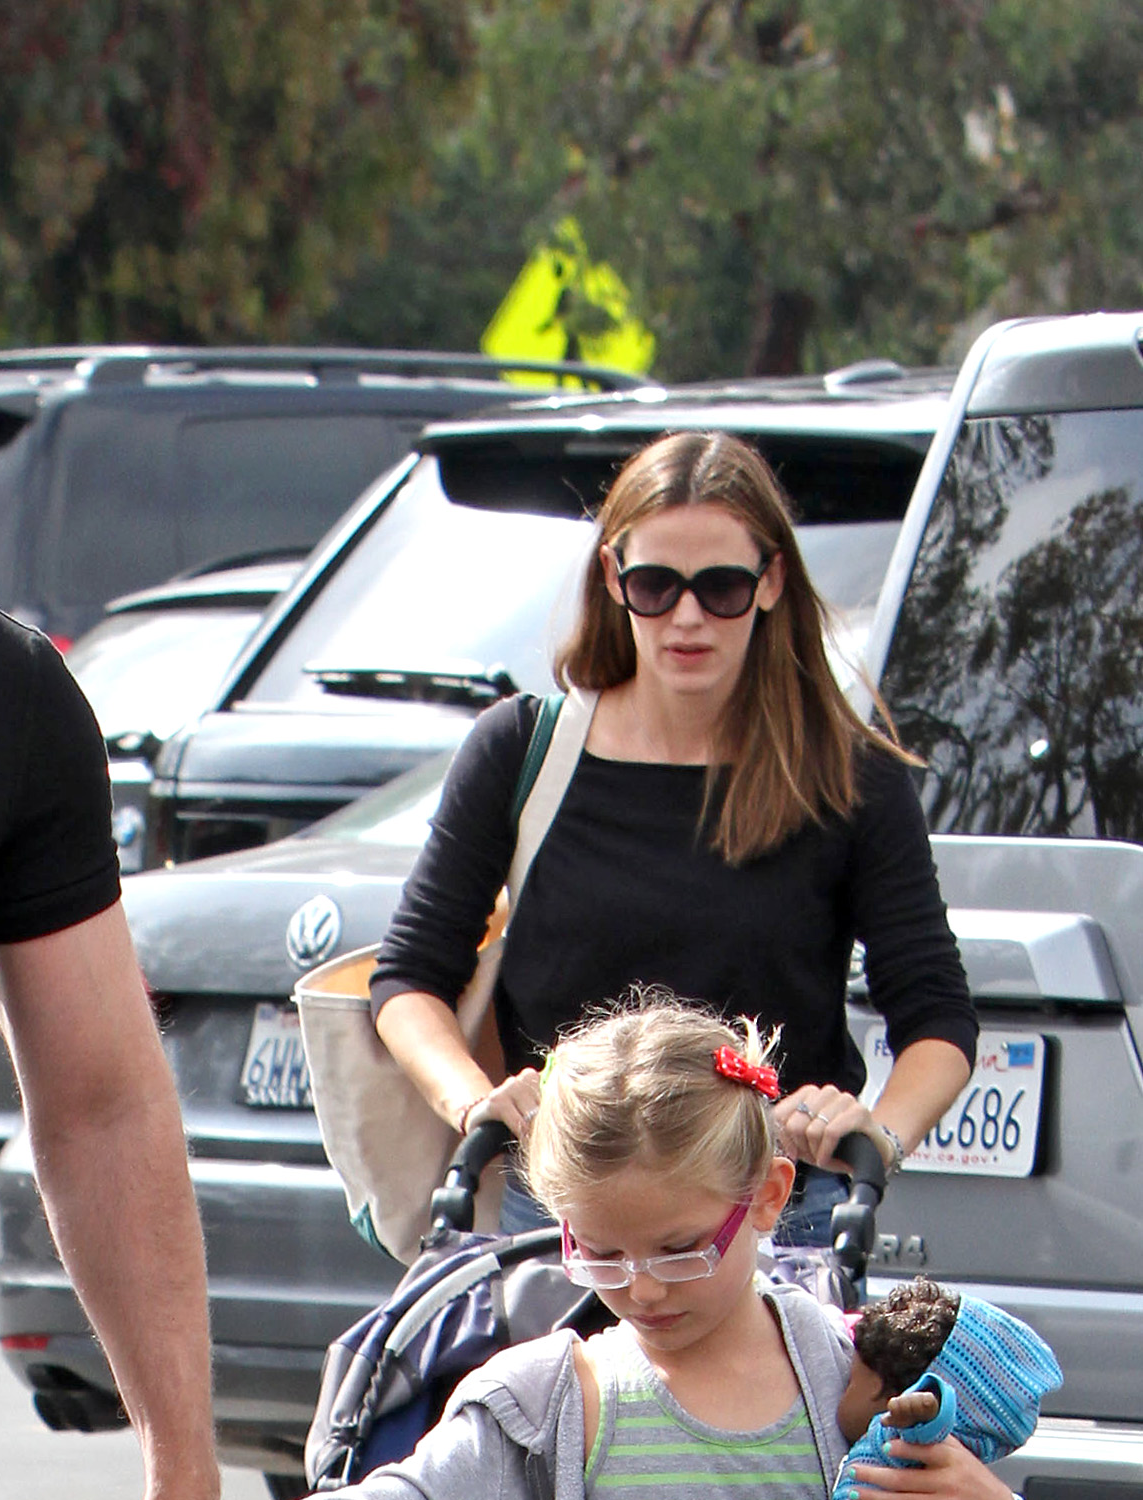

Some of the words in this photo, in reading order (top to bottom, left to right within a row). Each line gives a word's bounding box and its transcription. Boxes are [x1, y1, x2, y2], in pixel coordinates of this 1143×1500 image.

[924, 1086, 1026, 1151] C686
[907, 1149, 988, 1164] mv.ca.gov
[869, 1232, 928, 1265] R4
